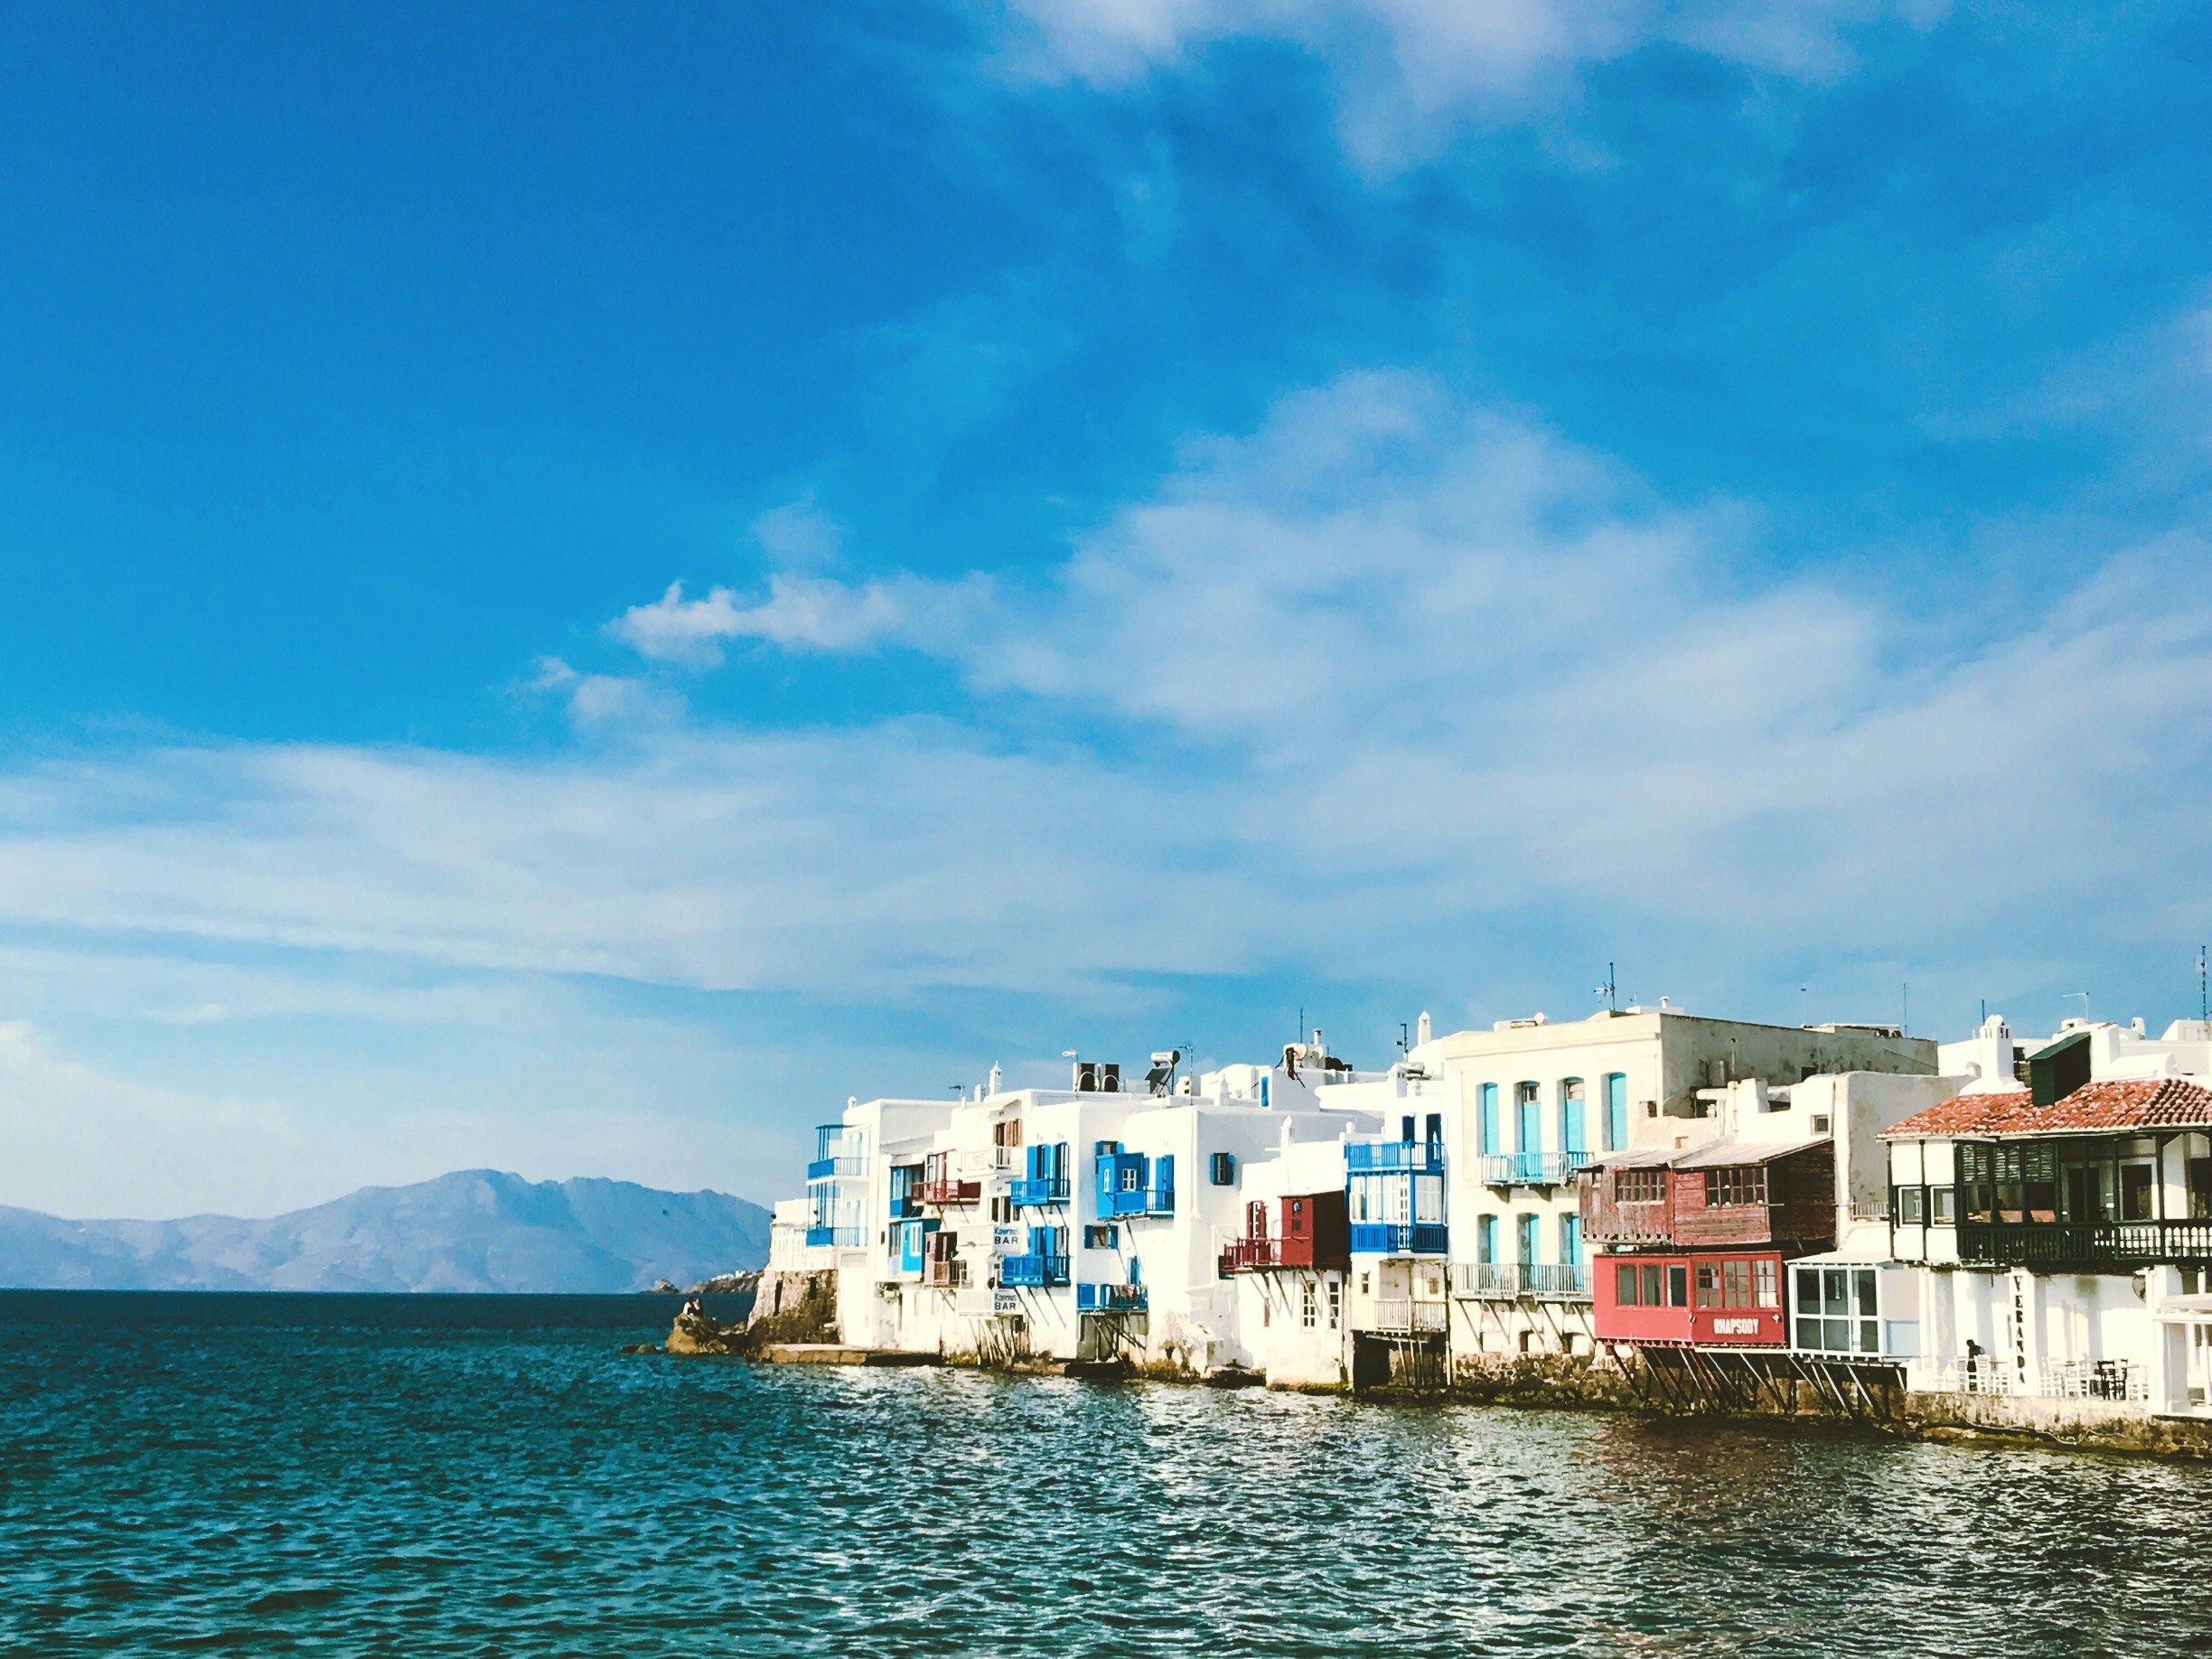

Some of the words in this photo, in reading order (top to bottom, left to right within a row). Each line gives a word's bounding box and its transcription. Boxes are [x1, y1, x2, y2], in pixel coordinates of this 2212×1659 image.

[994, 1236, 1018, 1245] BAR
[994, 1301, 1017, 1310] BAR
[1713, 1318, 1759, 1335] RHAPSODY
[2013, 1275, 2026, 1384] VERANDA
